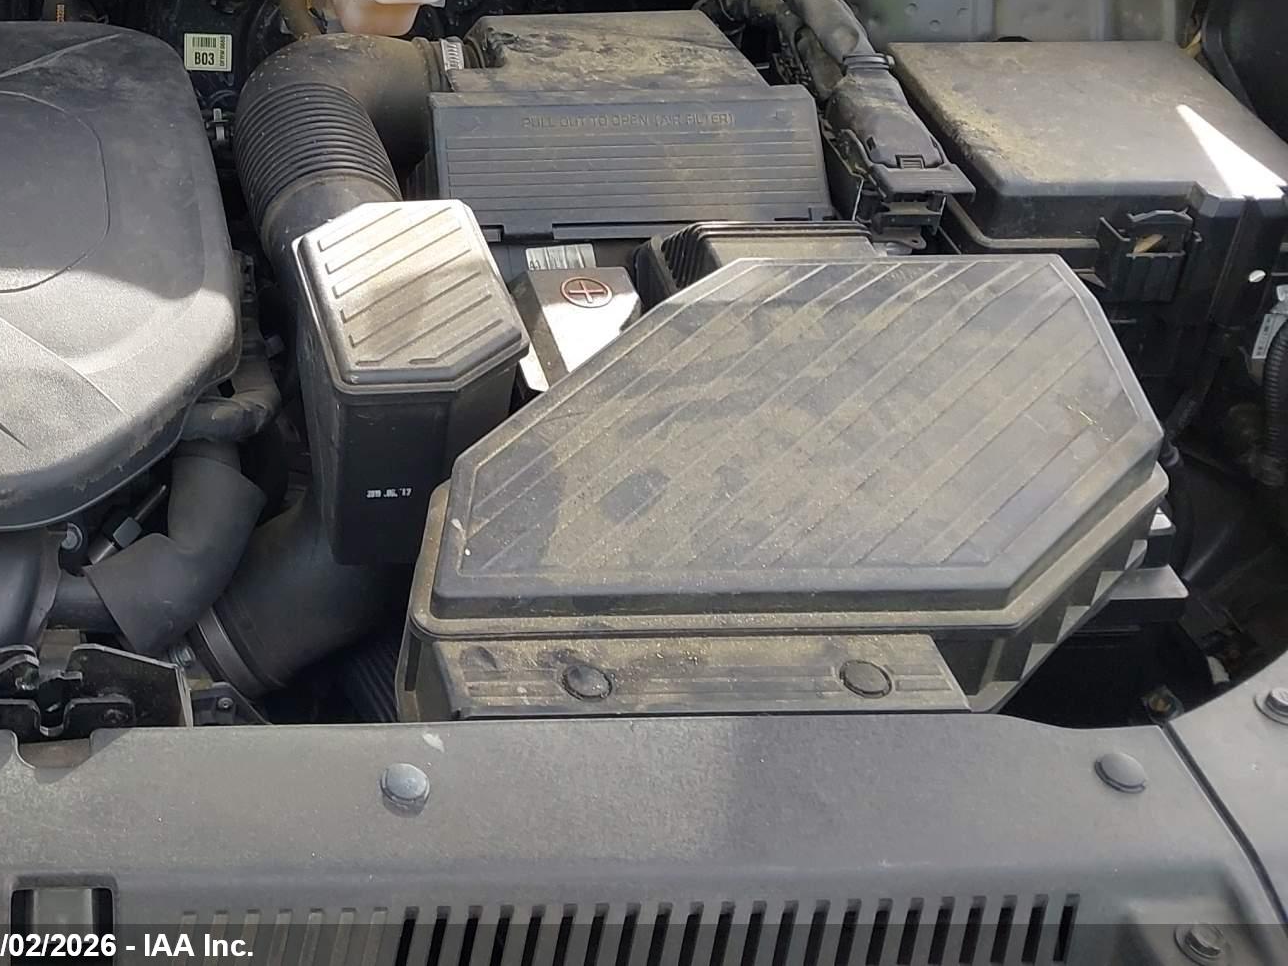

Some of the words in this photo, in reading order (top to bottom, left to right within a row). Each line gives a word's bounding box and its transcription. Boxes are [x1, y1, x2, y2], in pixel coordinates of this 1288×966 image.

[194, 52, 215, 66] B03
[521, 115, 556, 129] PULL
[559, 114, 586, 128] OUT
[590, 114, 609, 127] TO
[612, 113, 649, 127] OPEN
[687, 113, 737, 126] FILTER)
